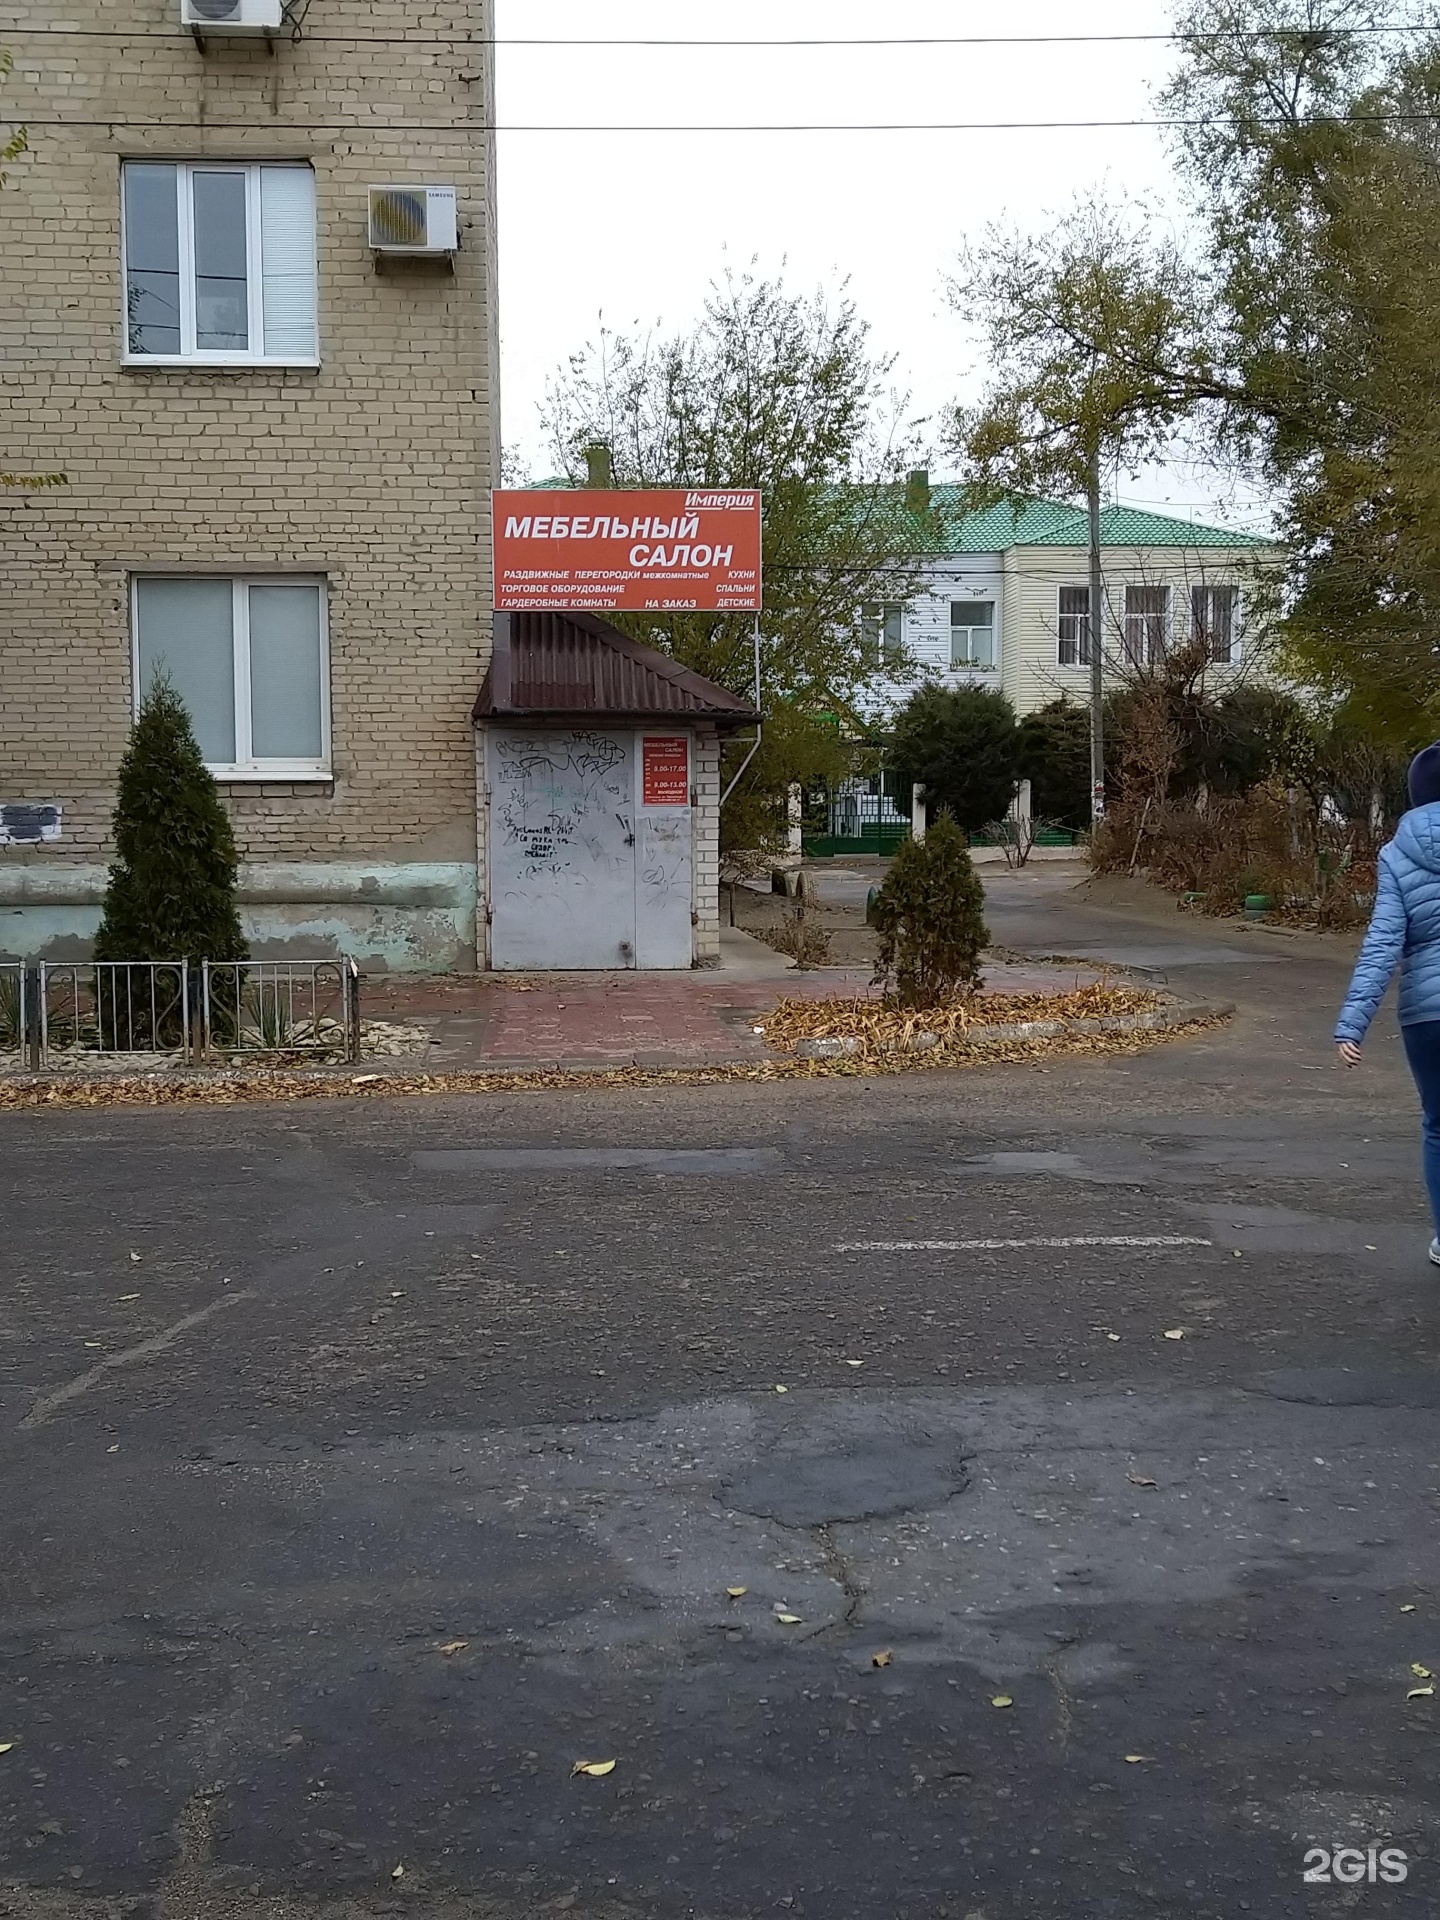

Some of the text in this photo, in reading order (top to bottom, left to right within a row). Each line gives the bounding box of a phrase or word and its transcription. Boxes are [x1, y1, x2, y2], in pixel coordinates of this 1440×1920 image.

[685, 493, 754, 508] Империя
[504, 511, 699, 538] МЕБЕЛЬНЫЙ
[629, 545, 733, 566] САЛОН
[504, 571, 569, 579] РАЗДВИЖНЫЕ
[574, 571, 640, 580] ПЕРЕГОРОДКИ
[728, 570, 755, 579] КУХНИ
[501, 584, 625, 593] ТОРГОВОЕ ОБОРУДОВАНИЕ
[716, 584, 755, 593] СПАЛЬНИ
[501, 598, 616, 607] ГАРДЕРОБНЫЕ КОМНАТЫ
[645, 599, 696, 608] НА ЗАКАЗ
[717, 598, 755, 607] ДЕТСКИЕ
